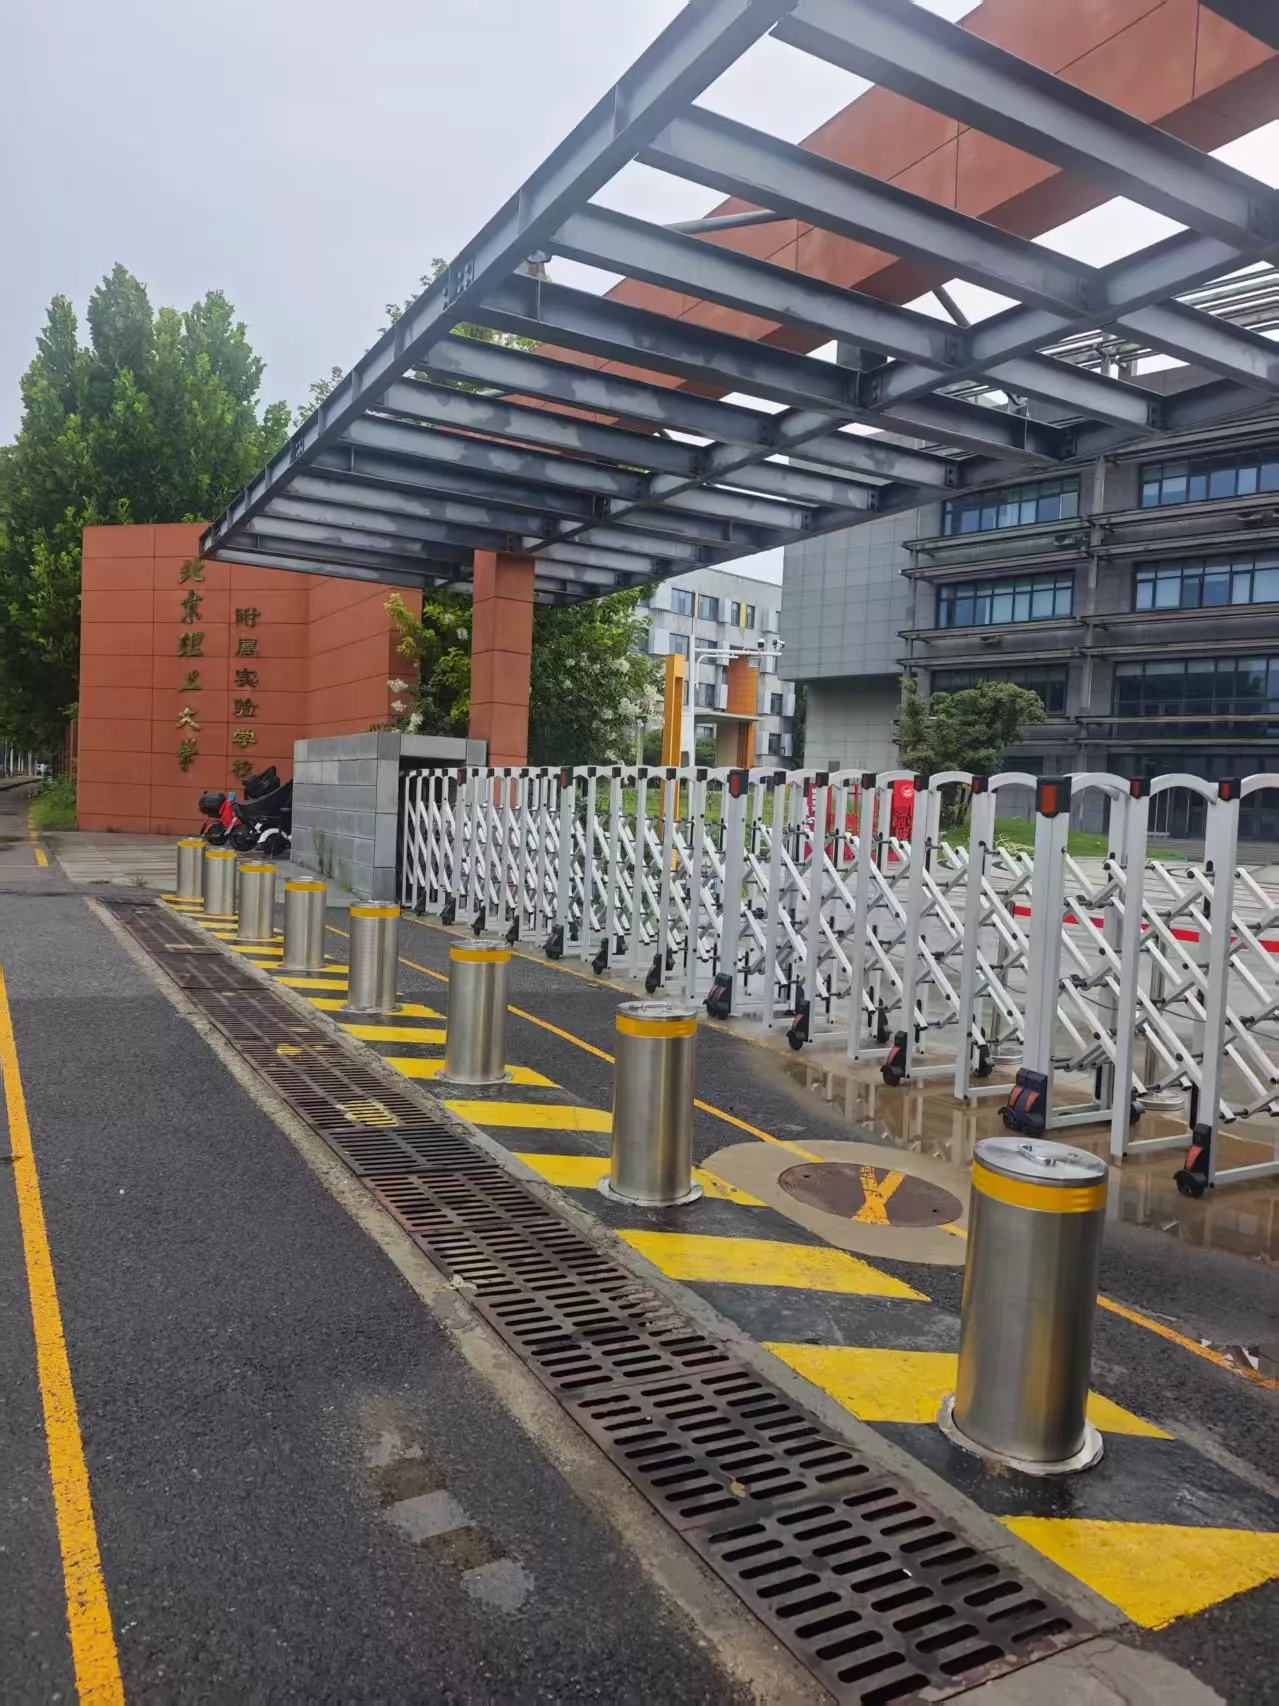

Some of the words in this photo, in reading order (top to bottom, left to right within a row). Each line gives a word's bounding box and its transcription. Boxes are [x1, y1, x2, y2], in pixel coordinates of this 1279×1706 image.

[176, 556, 206, 772] 北京理工大学
[231, 607, 261, 779] 附属实验学校
